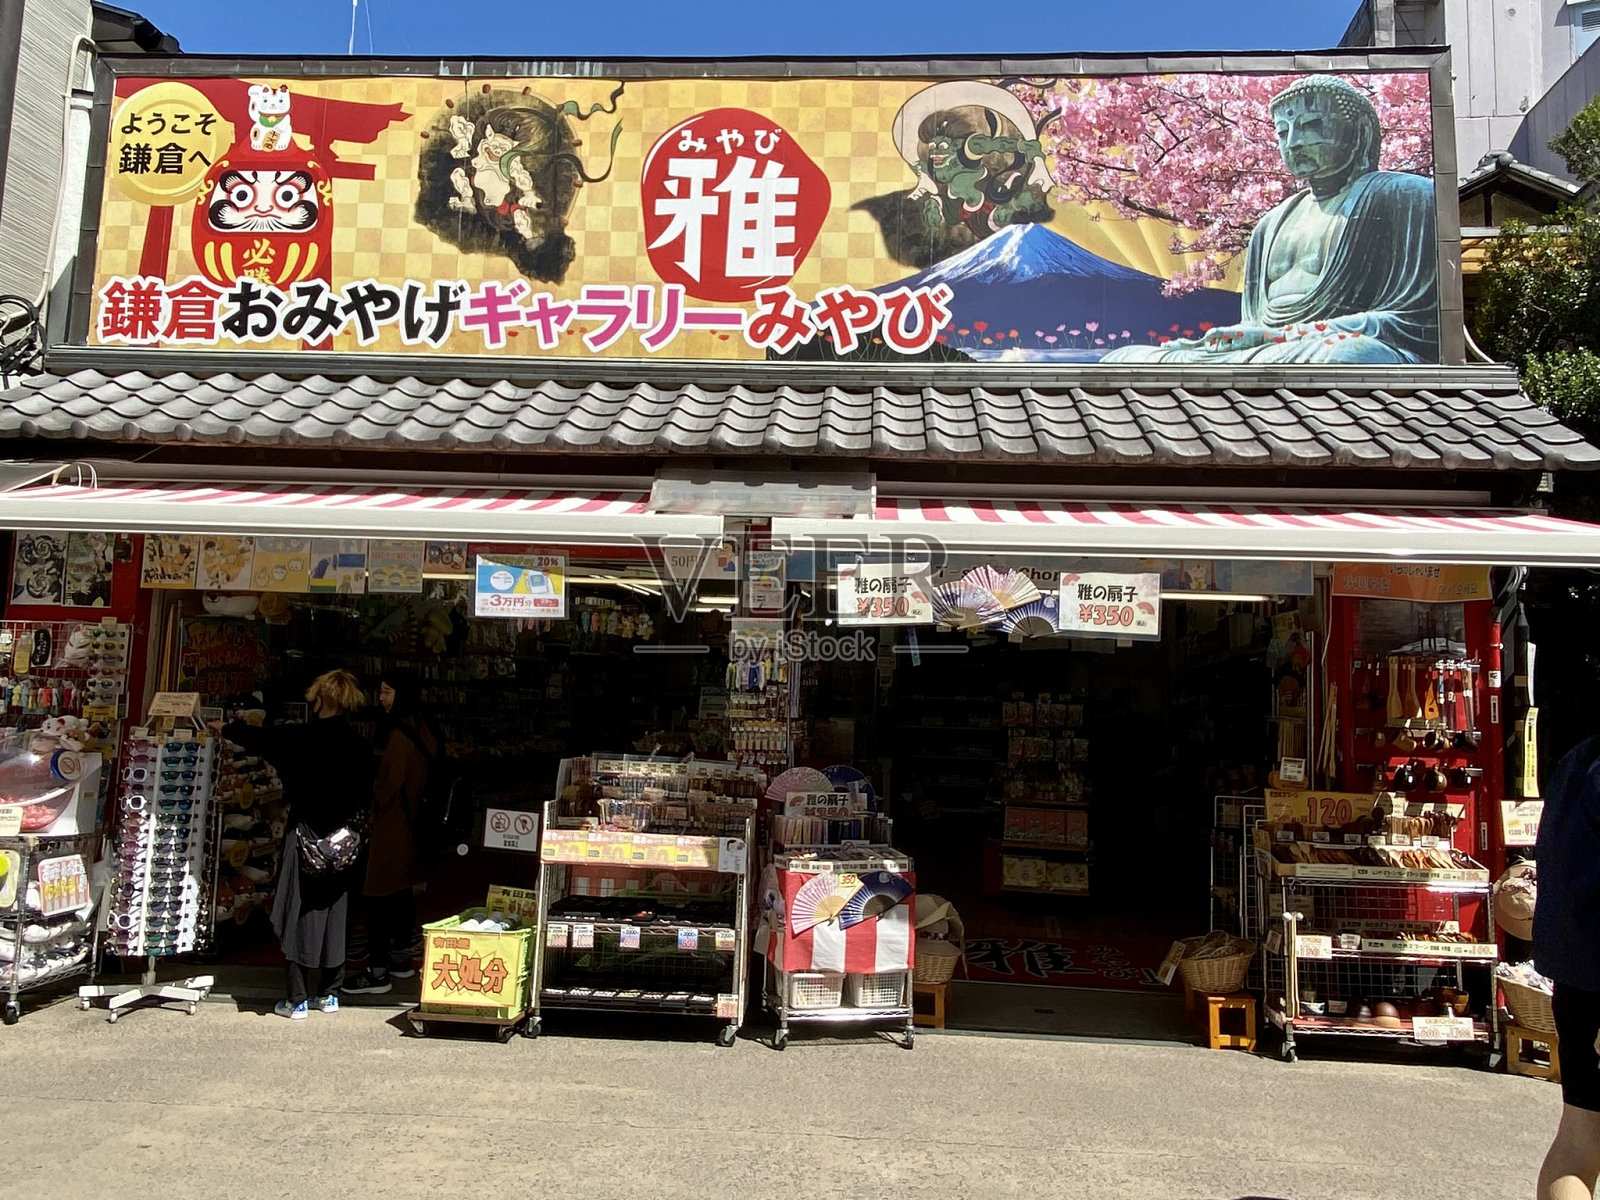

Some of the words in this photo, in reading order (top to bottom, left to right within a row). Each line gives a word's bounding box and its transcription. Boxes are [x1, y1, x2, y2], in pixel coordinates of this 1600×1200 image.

[120, 111, 217, 137] ようこそ
[678, 126, 782, 155] みやび
[118, 142, 212, 175] 鎌倉へ
[650, 155, 803, 283] 雅
[100, 278, 953, 350] 鎌倉おみやげギャラリーみやび
[854, 576, 912, 594] 雅の扇子
[1077, 584, 1139, 605] 雅の扇子
[856, 597, 909, 618] ¥350
[1078, 603, 1135, 628] ¥350
[1307, 796, 1353, 826] 120
[431, 954, 509, 993] 大処分
